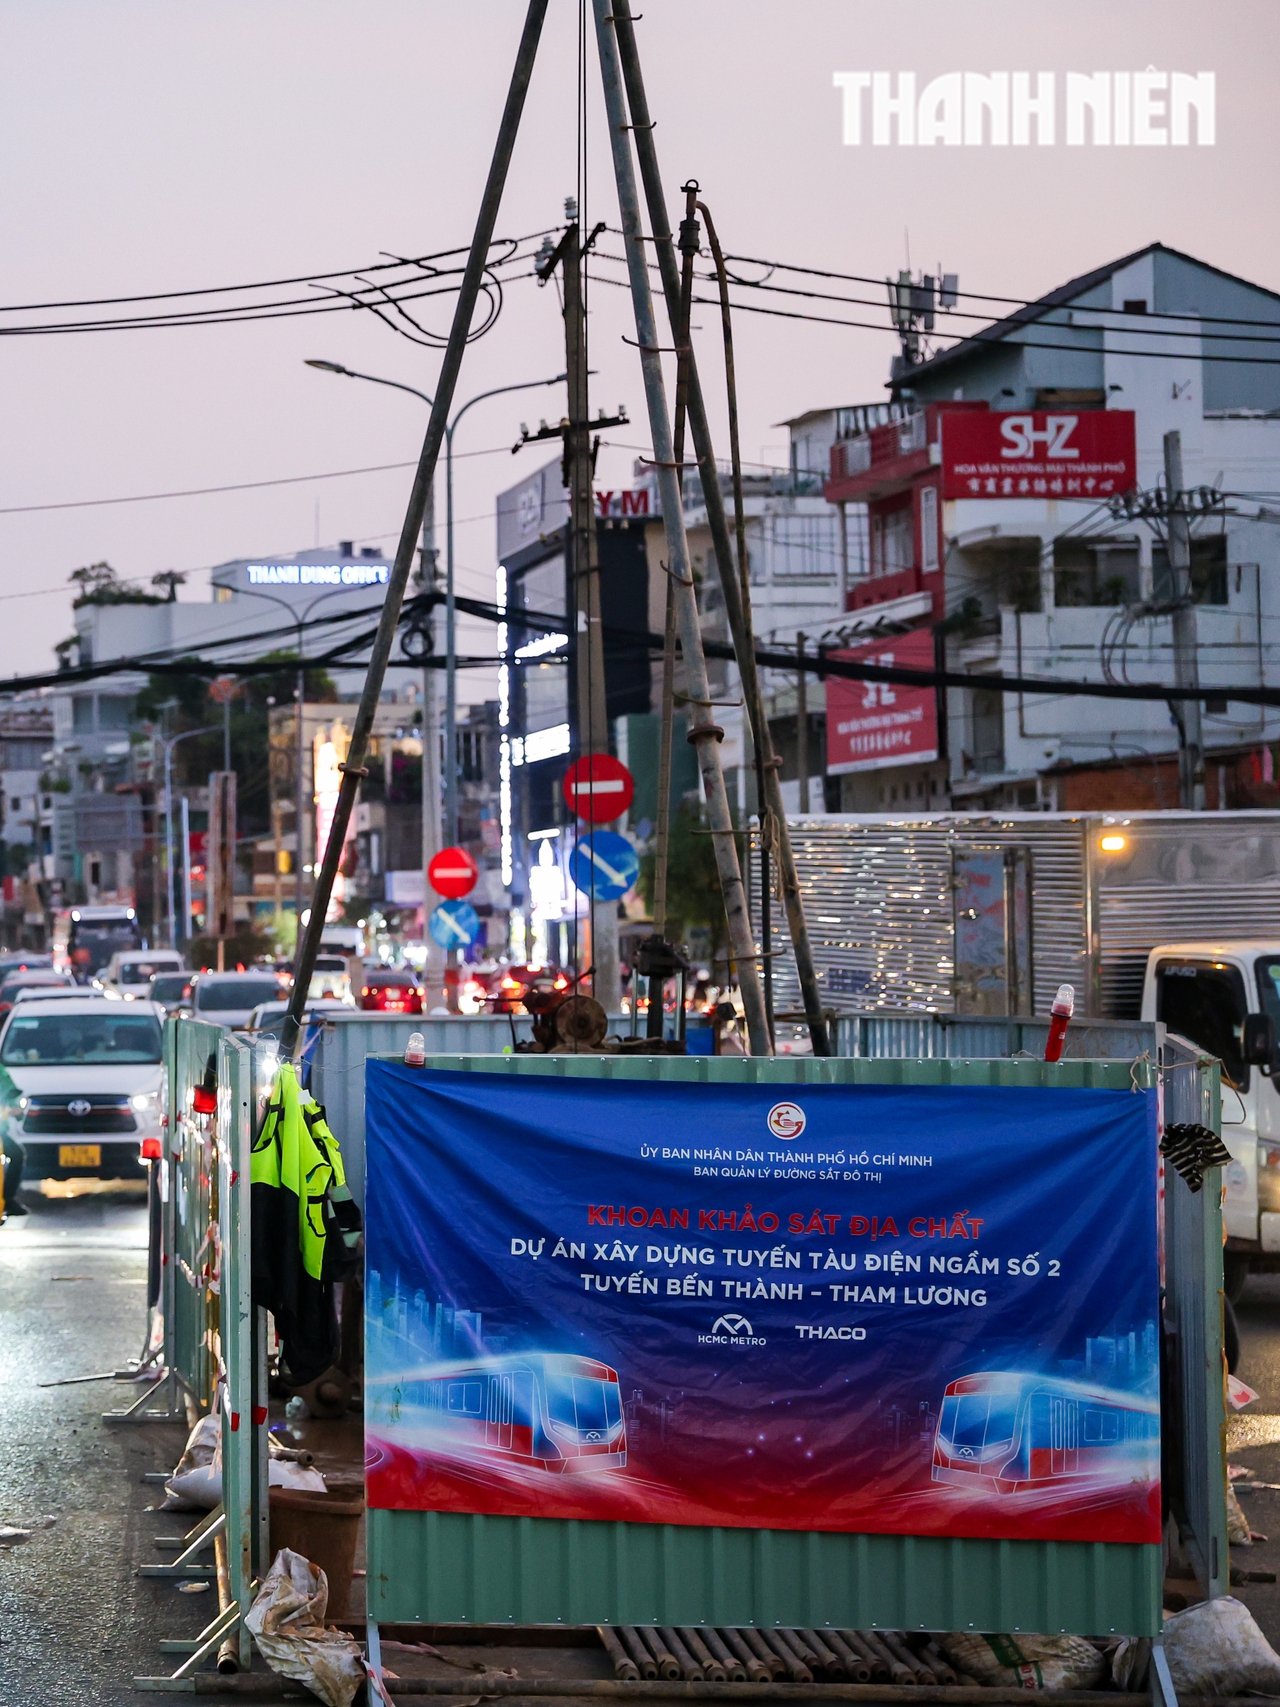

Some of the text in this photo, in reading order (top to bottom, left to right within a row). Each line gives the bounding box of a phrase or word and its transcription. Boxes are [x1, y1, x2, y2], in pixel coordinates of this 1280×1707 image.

[1000, 415, 1080, 458] SHZ
[640, 1143, 933, 1167] ỦY BAN NHÂN DÂN THÀNH PHỐ HỒ CHÍ MINH
[693, 1164, 882, 1184] BAN QUẢN LÝ ĐƯỜNG SẮT ĐÔ THỊ
[587, 1203, 984, 1241] KHOAN KHẢO SÁT ĐỊA CHẤT
[511, 1237, 1061, 1277] DỰ ÁN XÂY DỰNG TUYẾN TÀU ĐIỆN NGẦM SỐ 2
[580, 1269, 658, 1295] TUYẾN
[666, 1272, 713, 1297] BẾN
[720, 1277, 803, 1300] THÀNH
[829, 1285, 896, 1304] THAM
[904, 1285, 987, 1307] LƯƠNG
[698, 1335, 767, 1346] HCMC METRO
[795, 1325, 866, 1341] THACO
